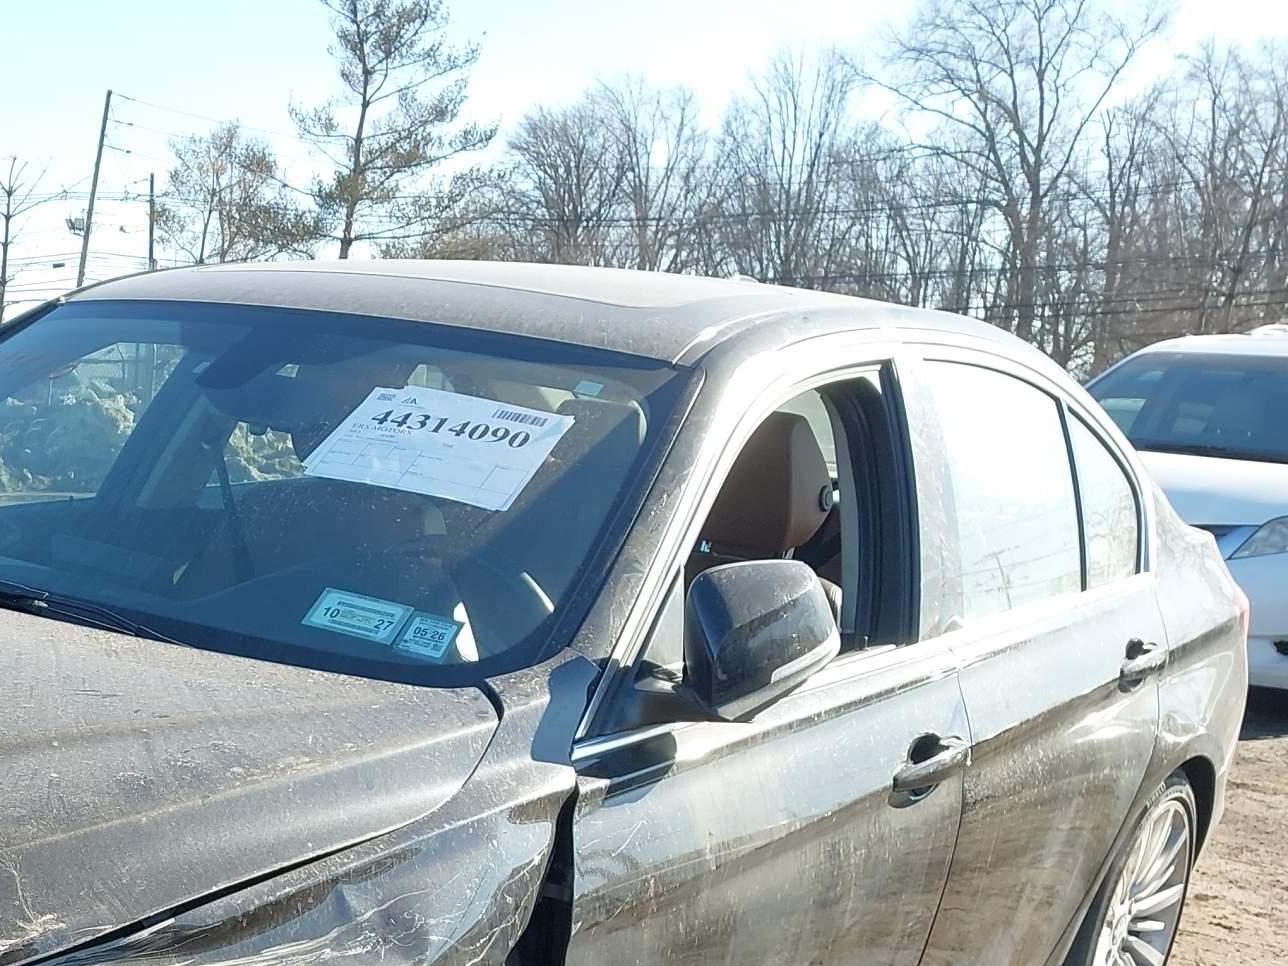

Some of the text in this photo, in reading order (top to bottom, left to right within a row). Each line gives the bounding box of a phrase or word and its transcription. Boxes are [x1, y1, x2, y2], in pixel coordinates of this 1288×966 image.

[371, 408, 531, 449] 44314090
[323, 606, 341, 618] 10
[374, 618, 394, 631] 27
[413, 626, 429, 637] 05
[430, 630, 446, 641] 26
